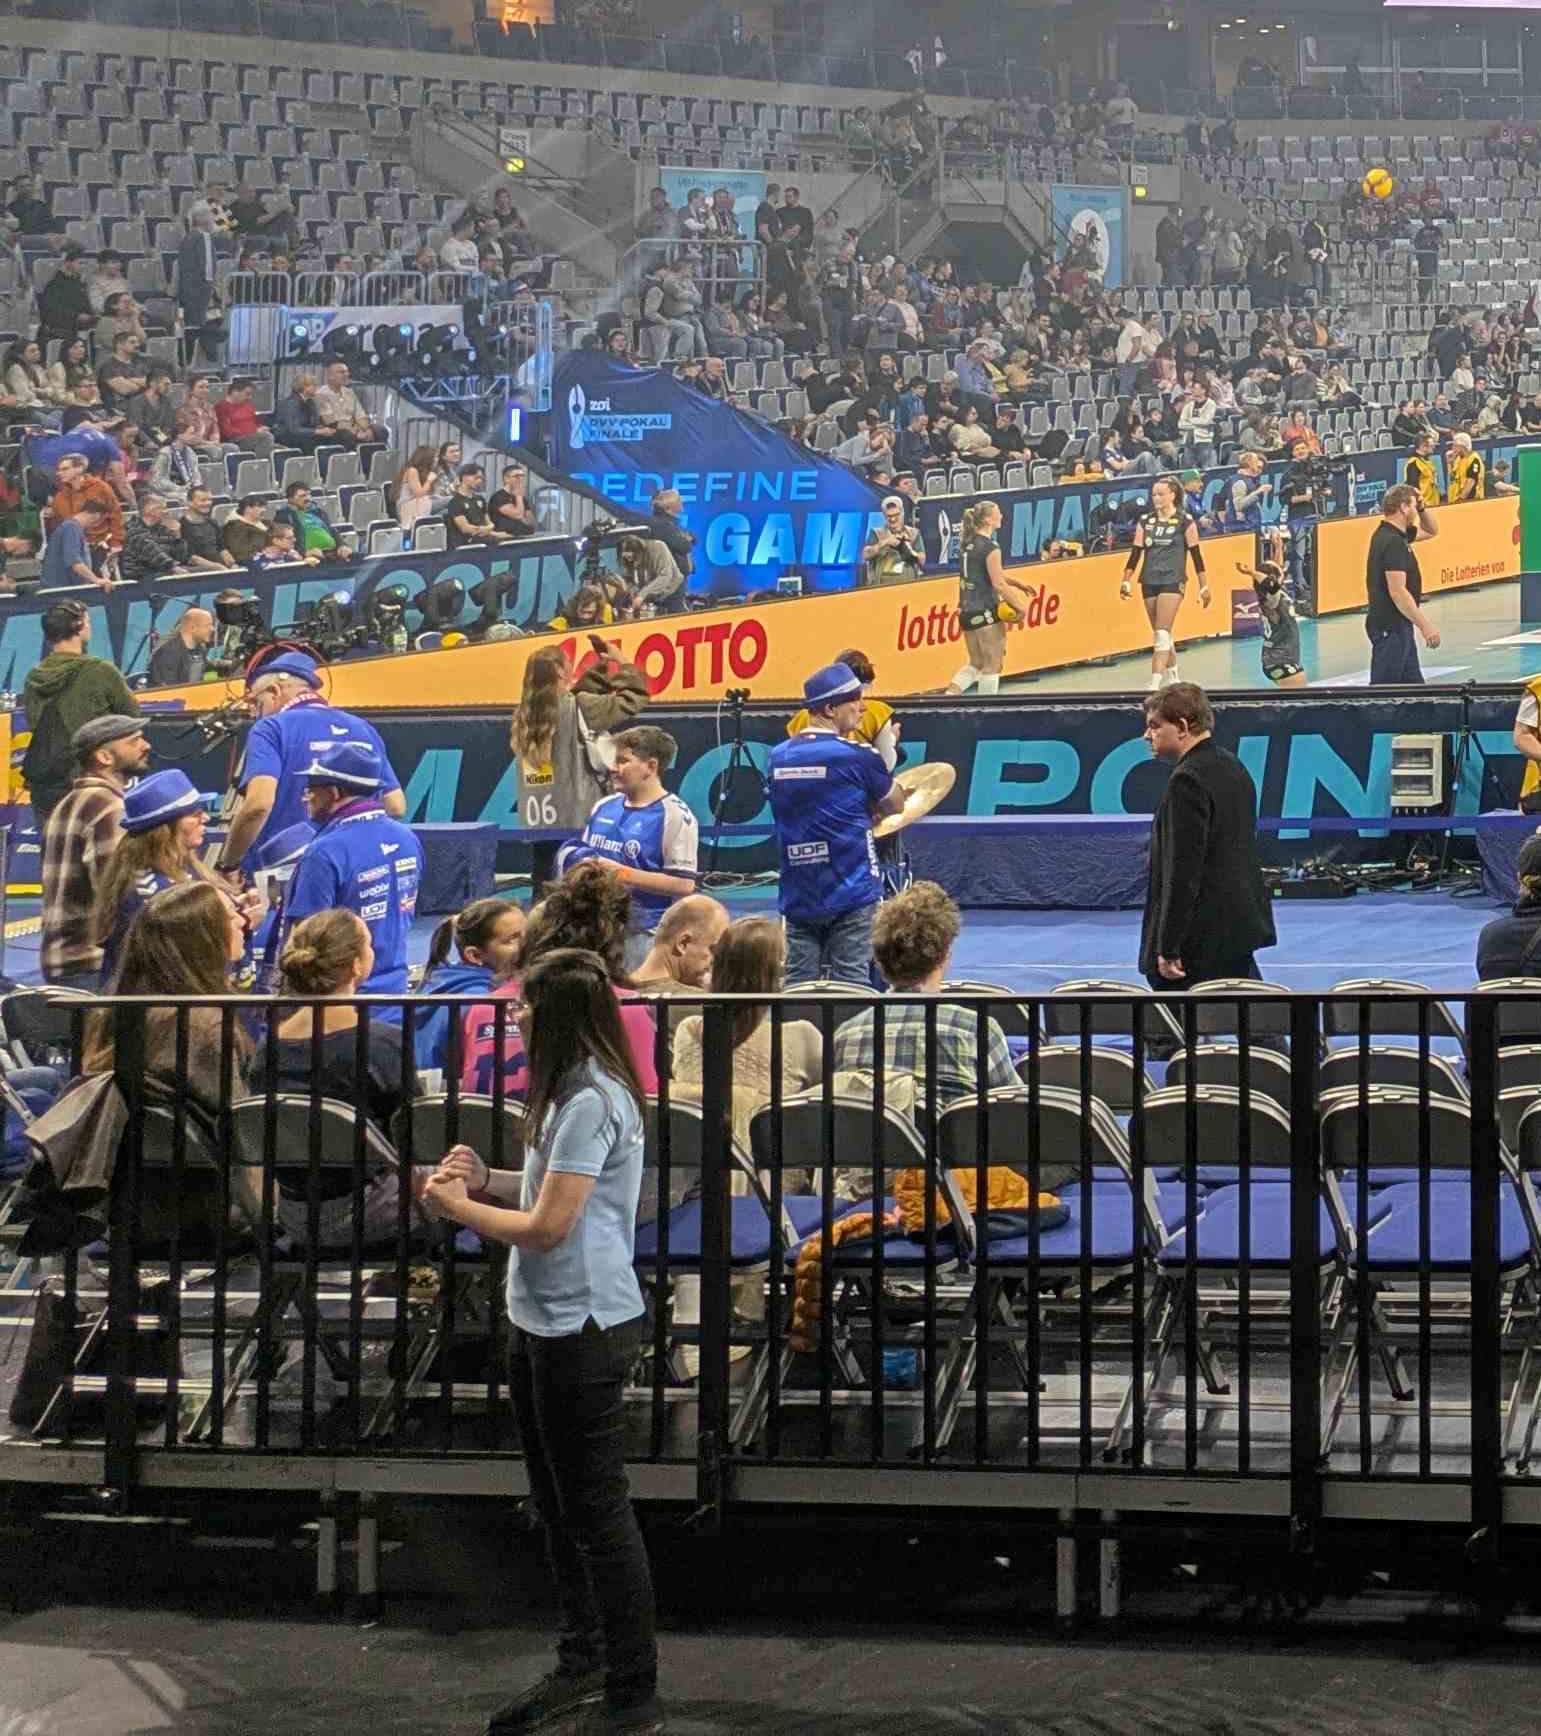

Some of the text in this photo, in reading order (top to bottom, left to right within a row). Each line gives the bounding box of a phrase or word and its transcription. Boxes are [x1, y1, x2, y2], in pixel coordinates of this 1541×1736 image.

[704, 511, 885, 566] GAM
[1440, 569, 1454, 584] Die
[1455, 565, 1491, 582] Lotterien
[608, 618, 769, 697] OTTO
[526, 774, 553, 785] Nikon
[525, 794, 558, 824] 06
